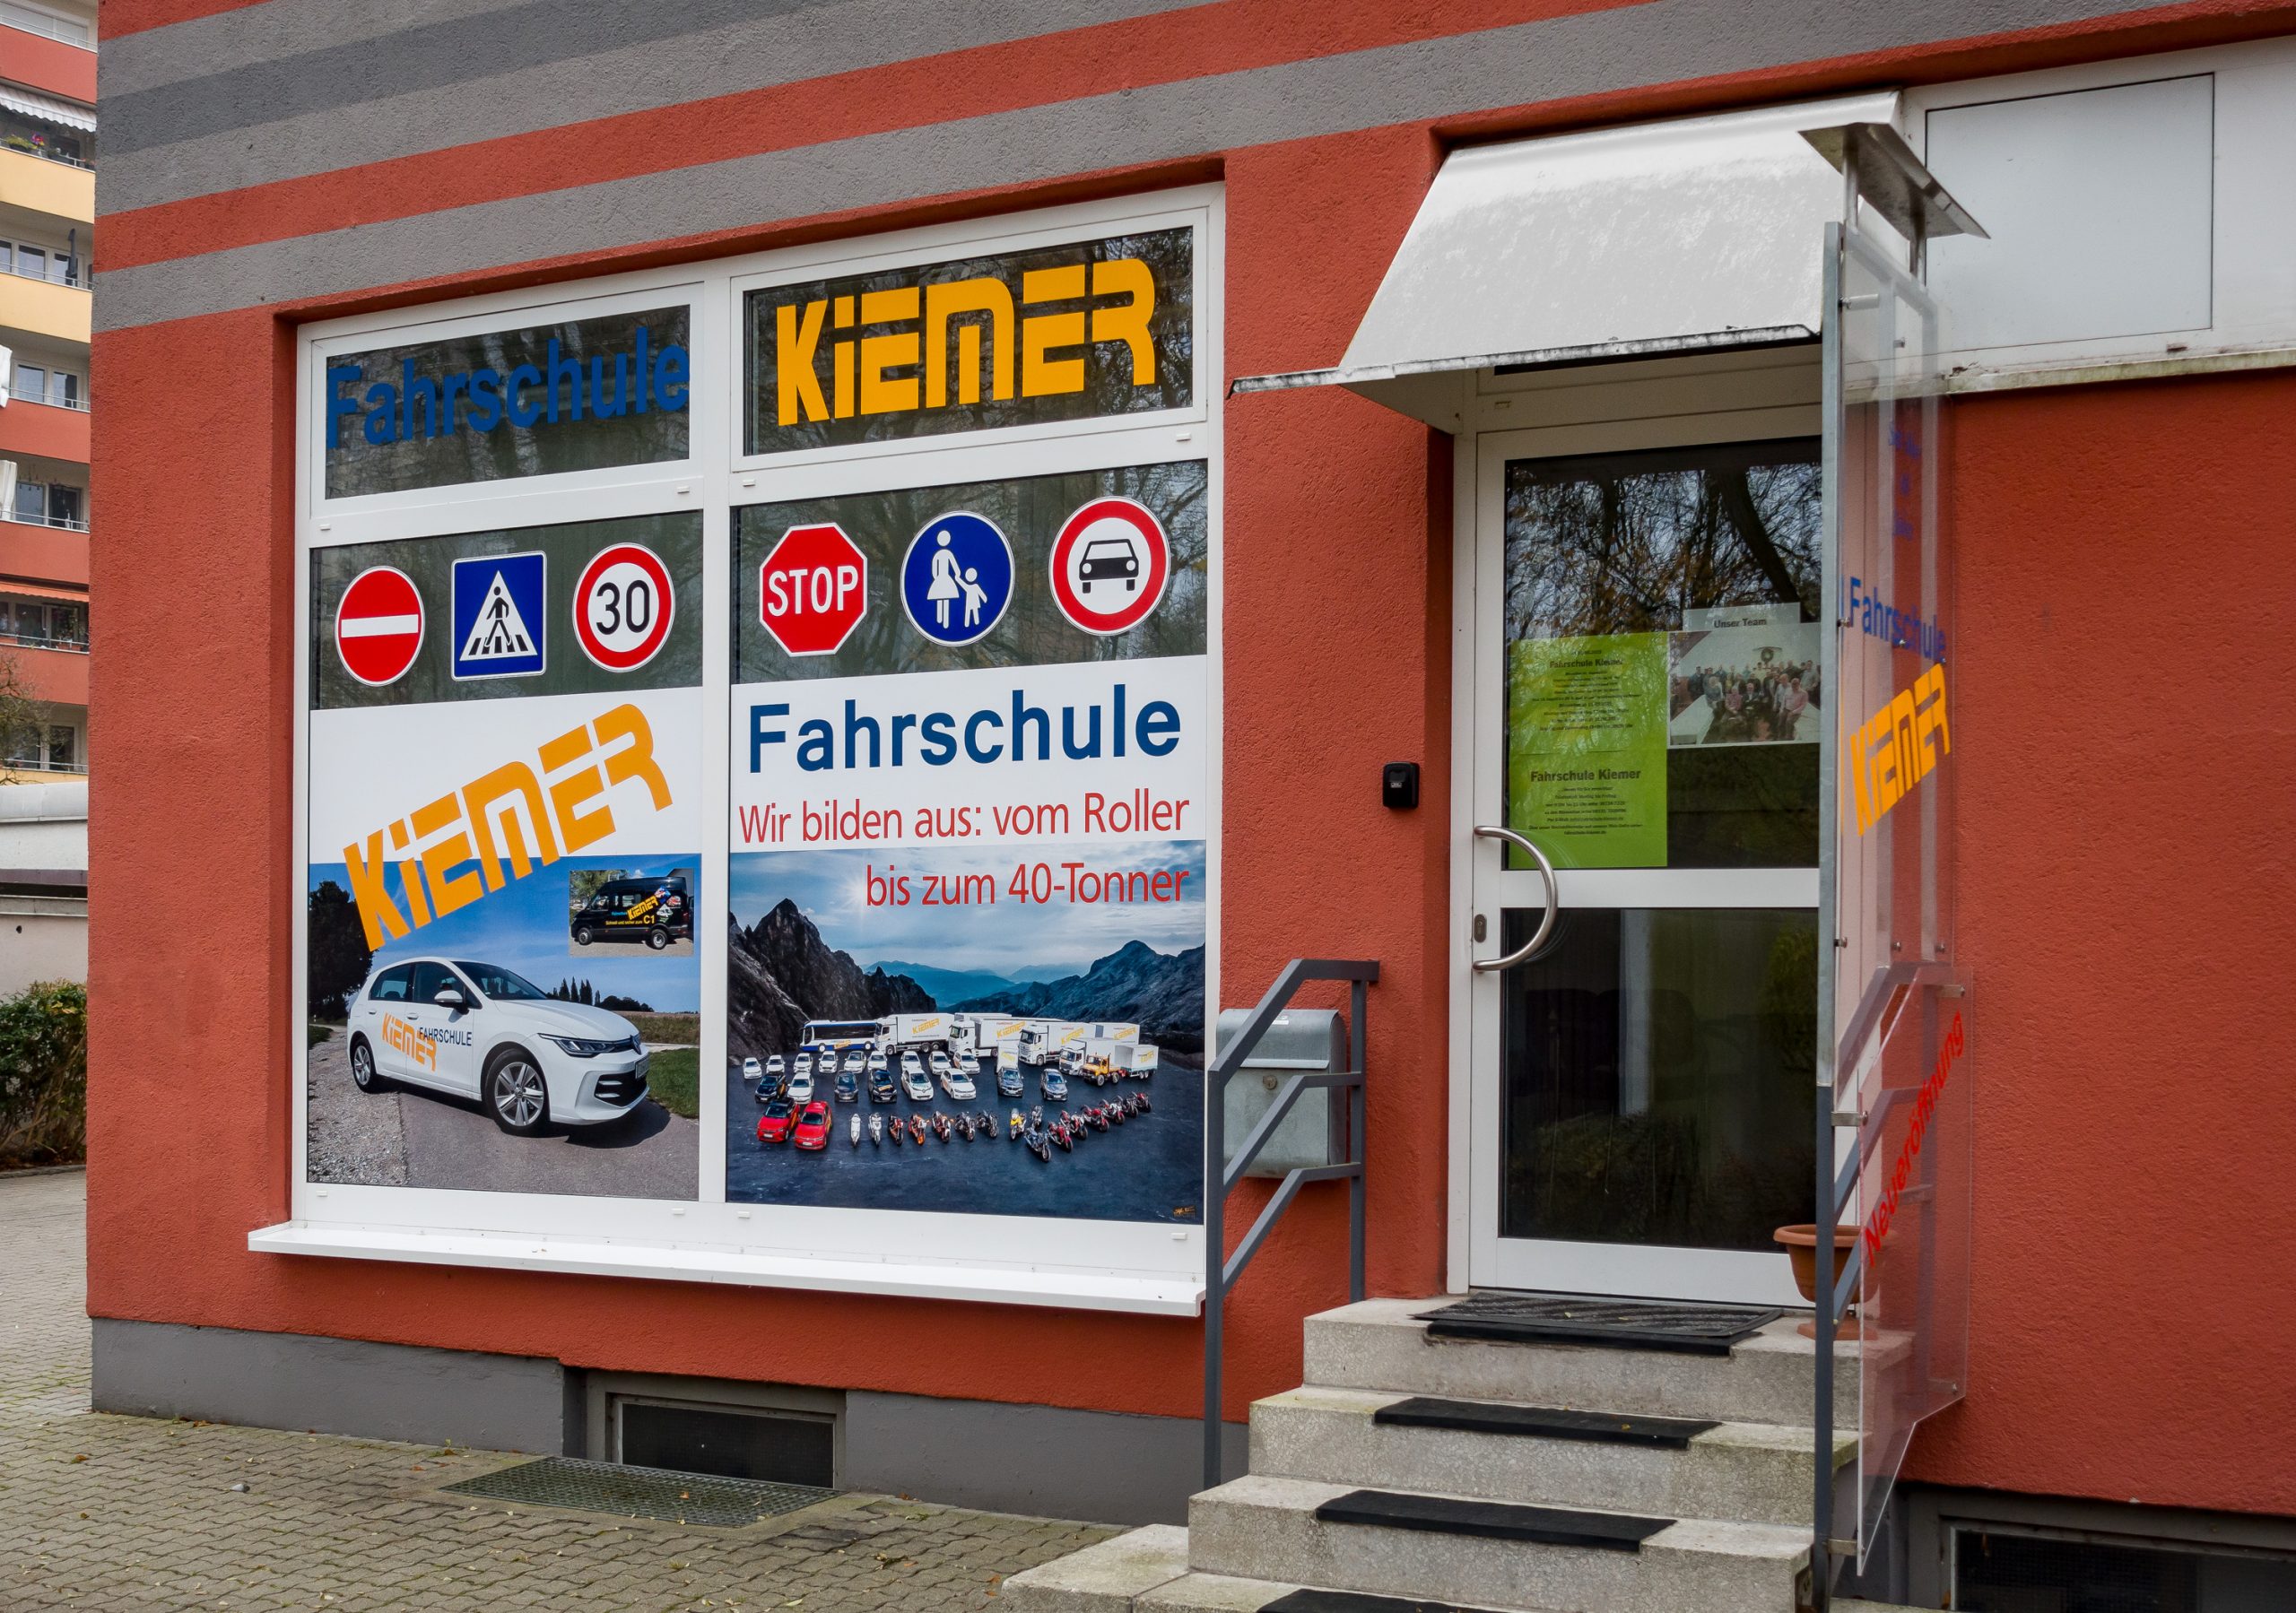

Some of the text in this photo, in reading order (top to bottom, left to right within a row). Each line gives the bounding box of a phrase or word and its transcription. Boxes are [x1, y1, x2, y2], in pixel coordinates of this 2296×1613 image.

[326, 325, 691, 449] Fahrschule
[596, 579, 651, 636] 30
[768, 563, 859, 616] STOP
[1714, 617, 1767, 629] Unser Team
[1850, 576, 1946, 663] Fahrschule
[749, 683, 1182, 774] Fahrschule
[1530, 768, 1641, 782] Fahrschule Kiemer
[738, 787, 1190, 844] Wir bilden aus: vom Roller
[866, 863, 1190, 906] bis zum 40-Tonner
[643, 915, 655, 924] C1
[419, 1027, 473, 1046] FAHRSCHULE
[1864, 1010, 1964, 1269] Neueröffnung
